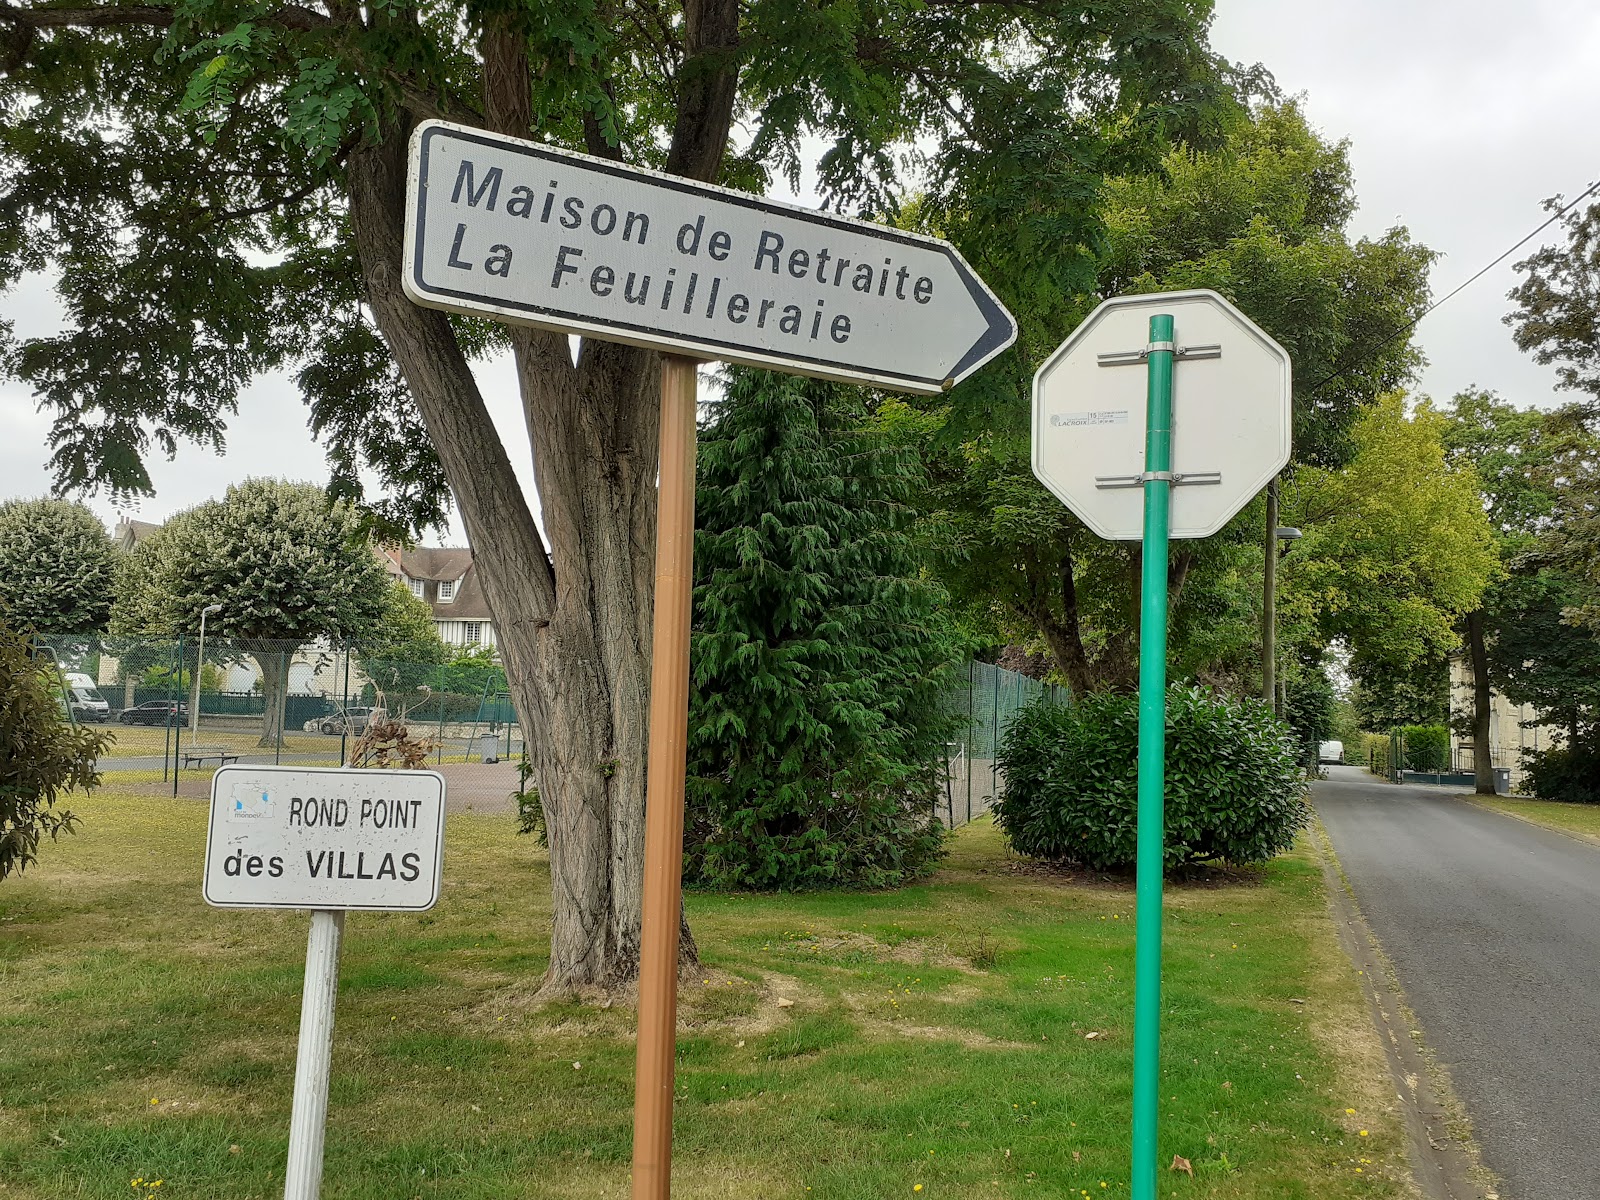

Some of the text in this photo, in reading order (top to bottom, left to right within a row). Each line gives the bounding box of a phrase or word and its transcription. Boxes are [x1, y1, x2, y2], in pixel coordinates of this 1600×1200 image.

[450, 159, 934, 305] Maison de Retraite
[447, 222, 852, 344] La Feuilleraie
[289, 797, 422, 829] ROND POINT
[223, 848, 421, 882] des VILLAS
